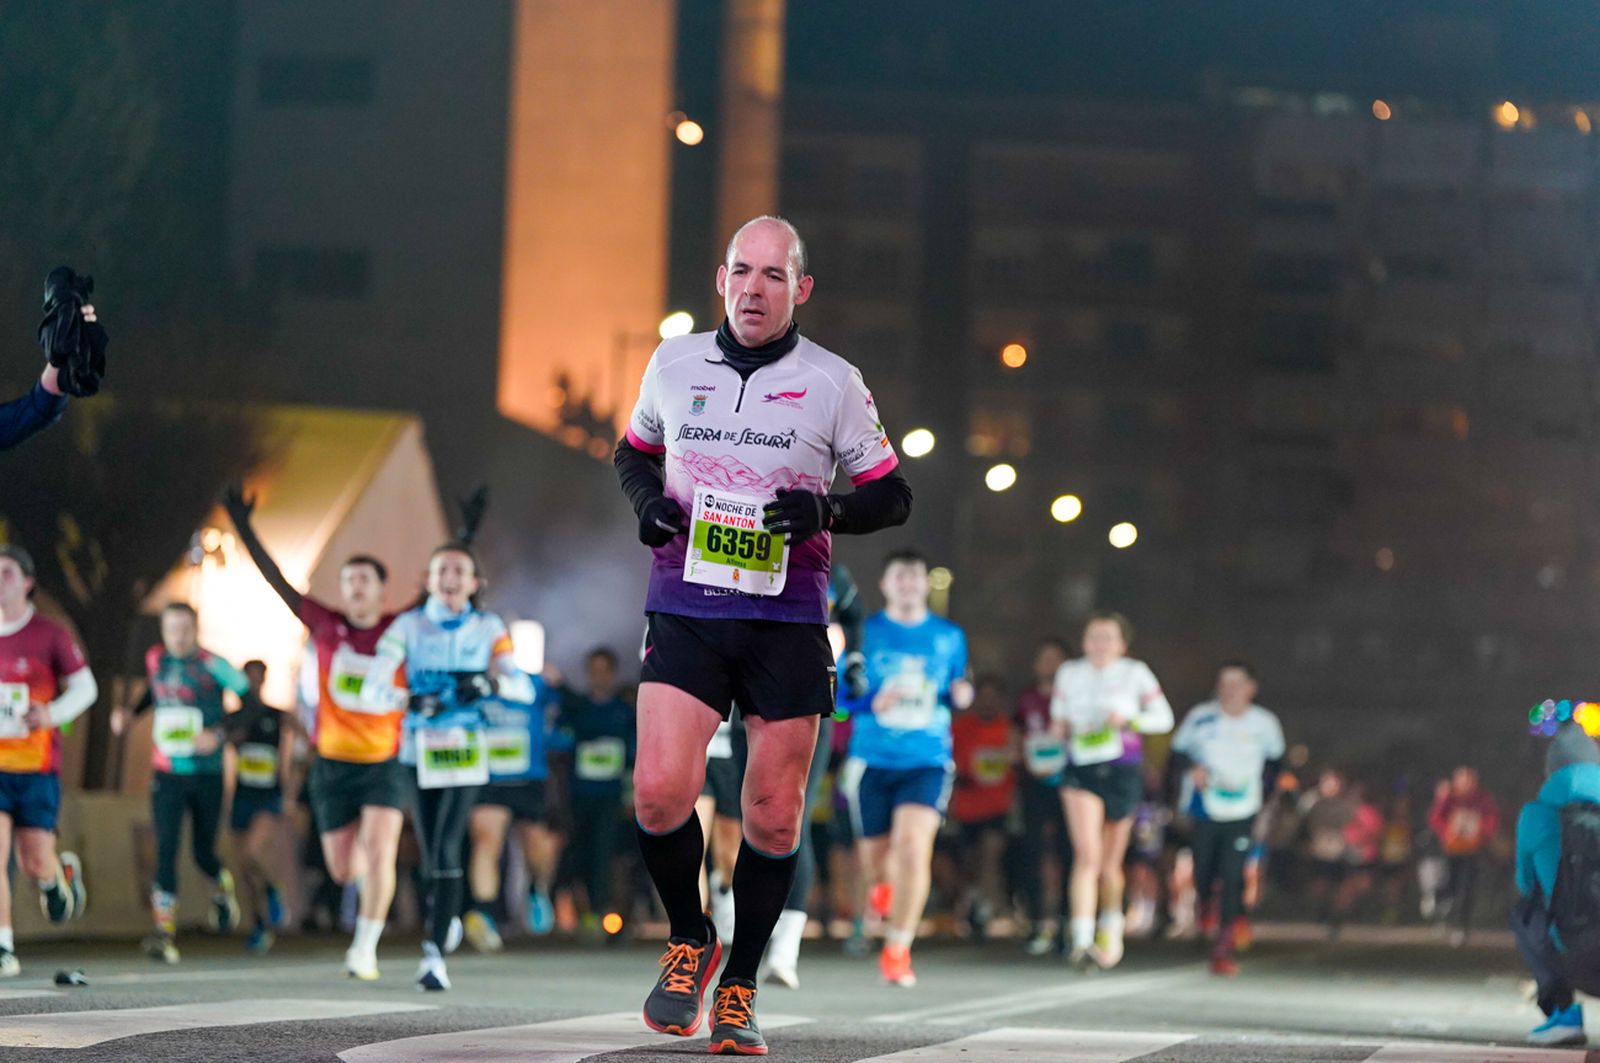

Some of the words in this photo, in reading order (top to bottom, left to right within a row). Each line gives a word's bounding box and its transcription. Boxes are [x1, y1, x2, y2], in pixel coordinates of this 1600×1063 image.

[675, 423, 722, 442] SIERRA
[724, 431, 738, 441] DE
[734, 427, 792, 450] SEGURA
[703, 510, 722, 523] SAN
[723, 514, 756, 529] ANTÓN
[714, 501, 744, 515] NOCHE
[744, 507, 758, 517] DE
[707, 524, 771, 561] 6359
